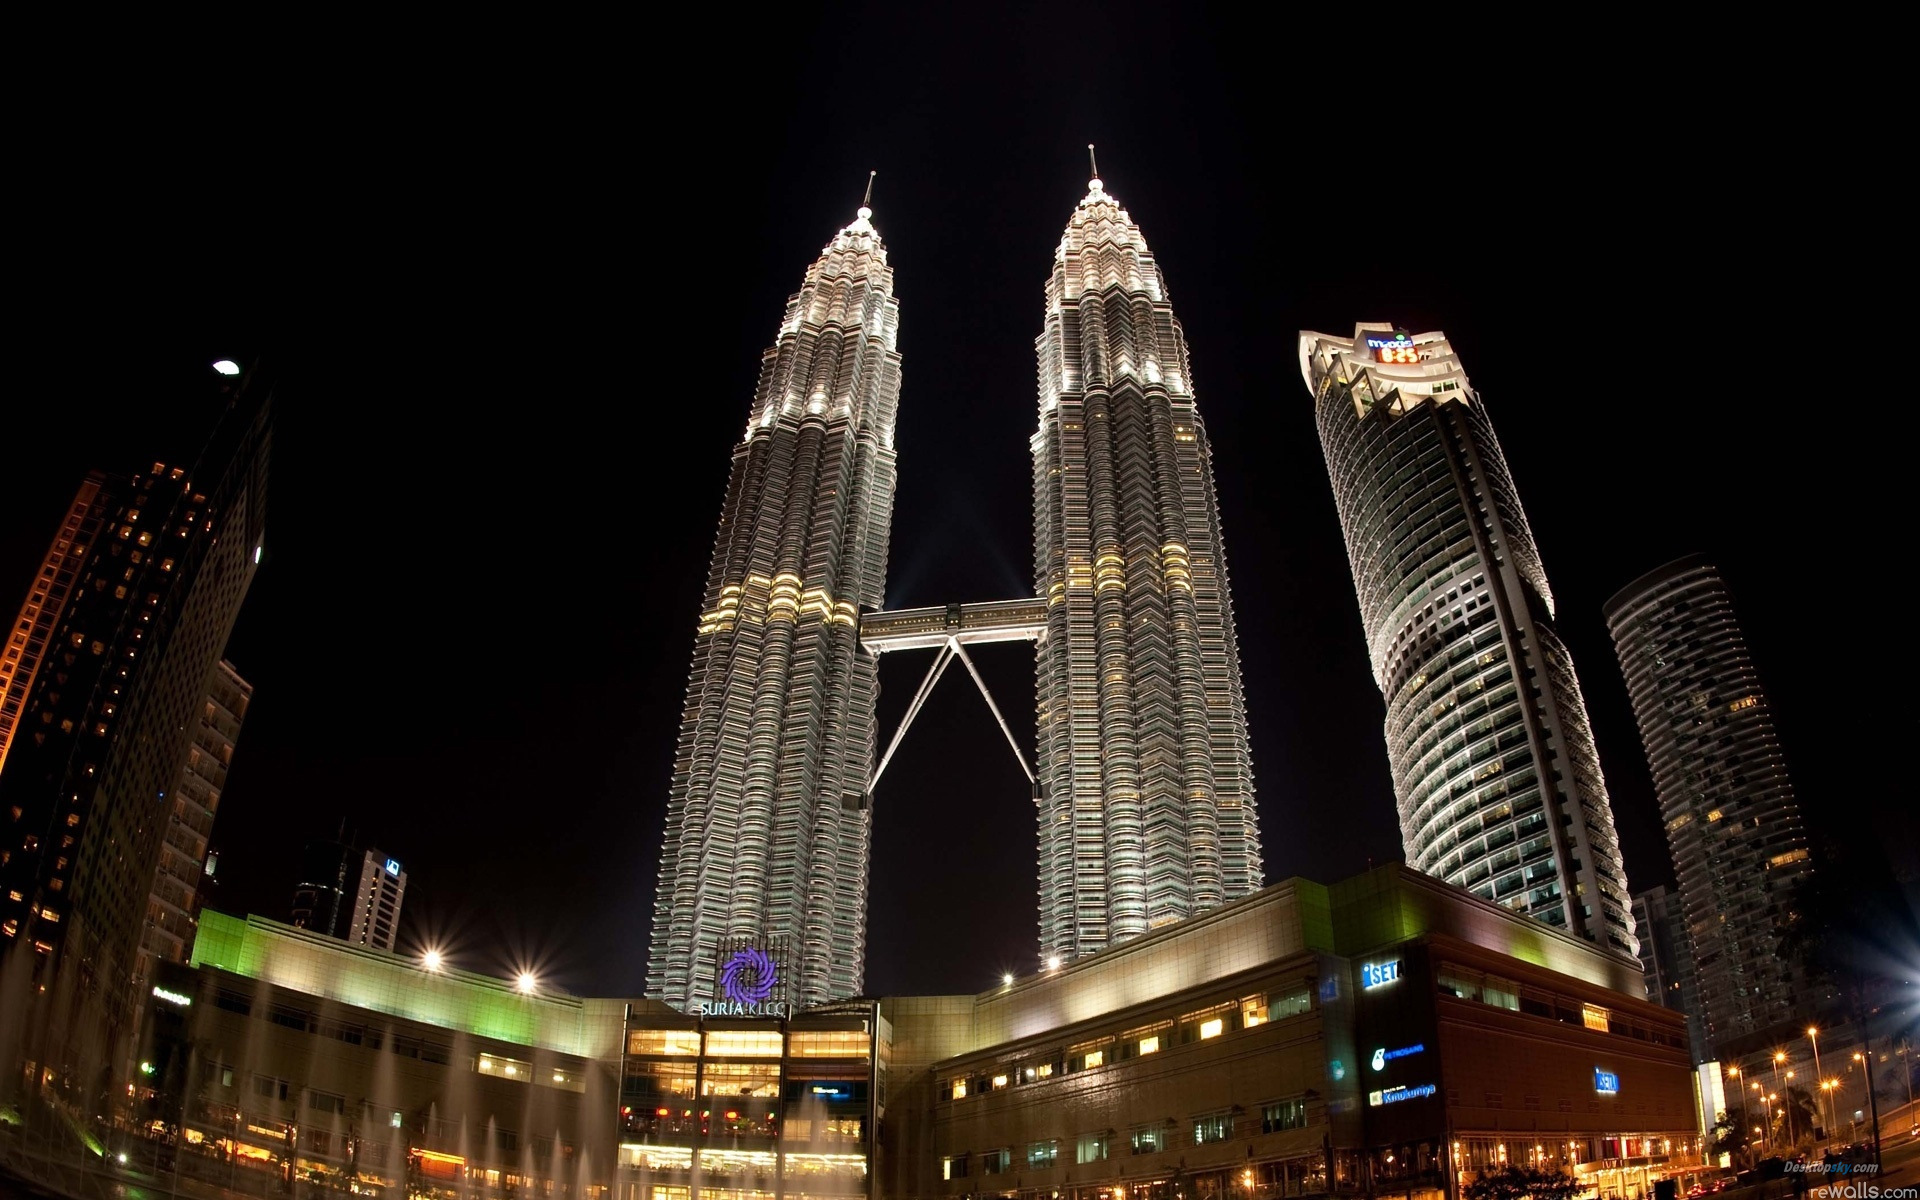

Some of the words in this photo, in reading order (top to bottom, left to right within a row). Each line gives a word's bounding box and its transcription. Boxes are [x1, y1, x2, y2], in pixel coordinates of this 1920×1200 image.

[1382, 348, 1417, 363] 8:25
[701, 1002, 744, 1016] SURIA
[749, 1002, 785, 1016] KLCC
